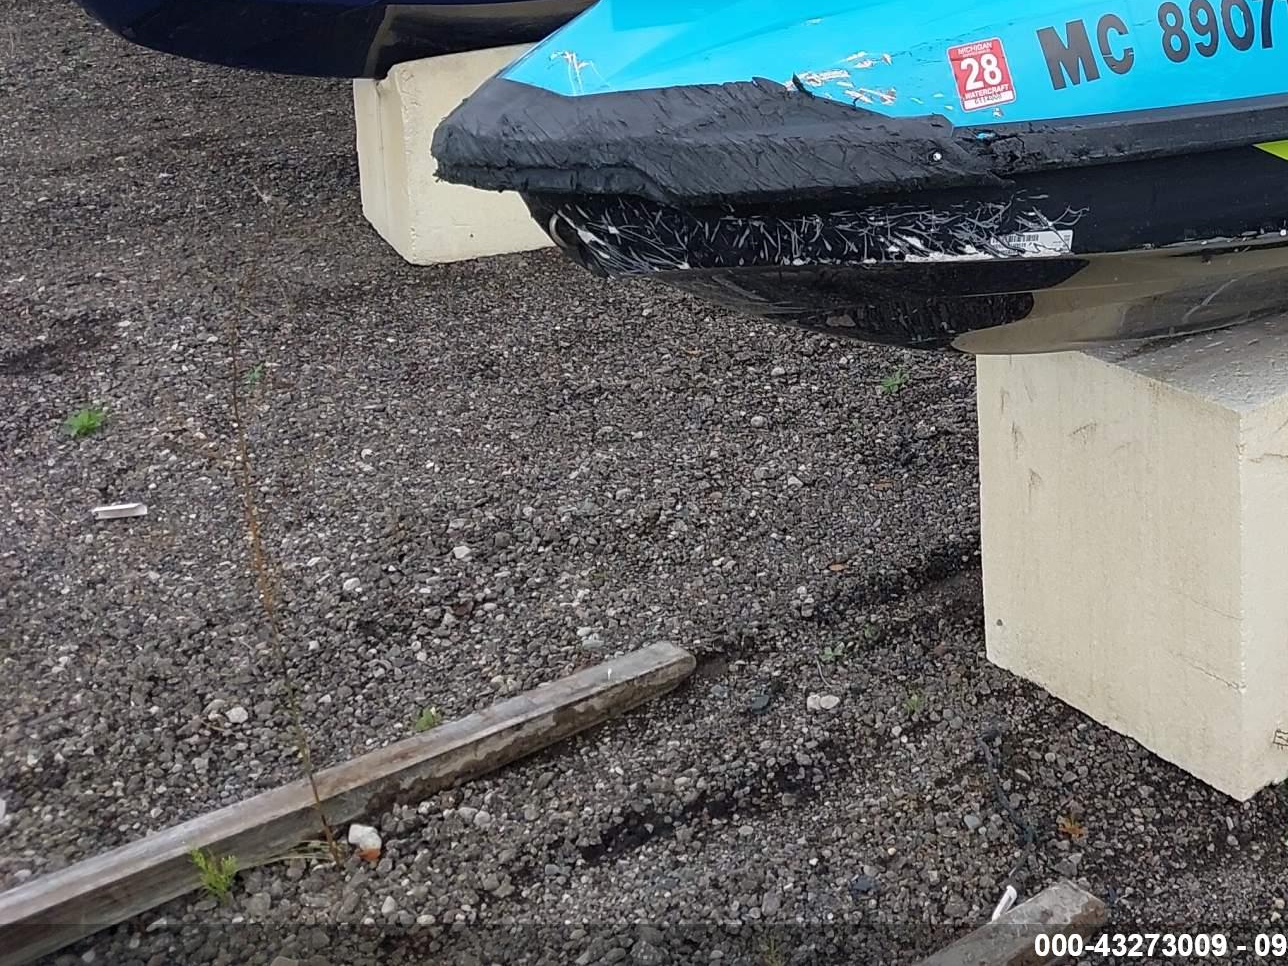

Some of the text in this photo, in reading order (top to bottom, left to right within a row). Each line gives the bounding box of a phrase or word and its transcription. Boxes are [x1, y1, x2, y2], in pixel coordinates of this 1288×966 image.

[957, 41, 993, 55] MICHIGAN
[1036, 12, 1135, 91] MC
[961, 53, 1003, 91] 28
[964, 83, 1009, 100] WATERCRAFT
